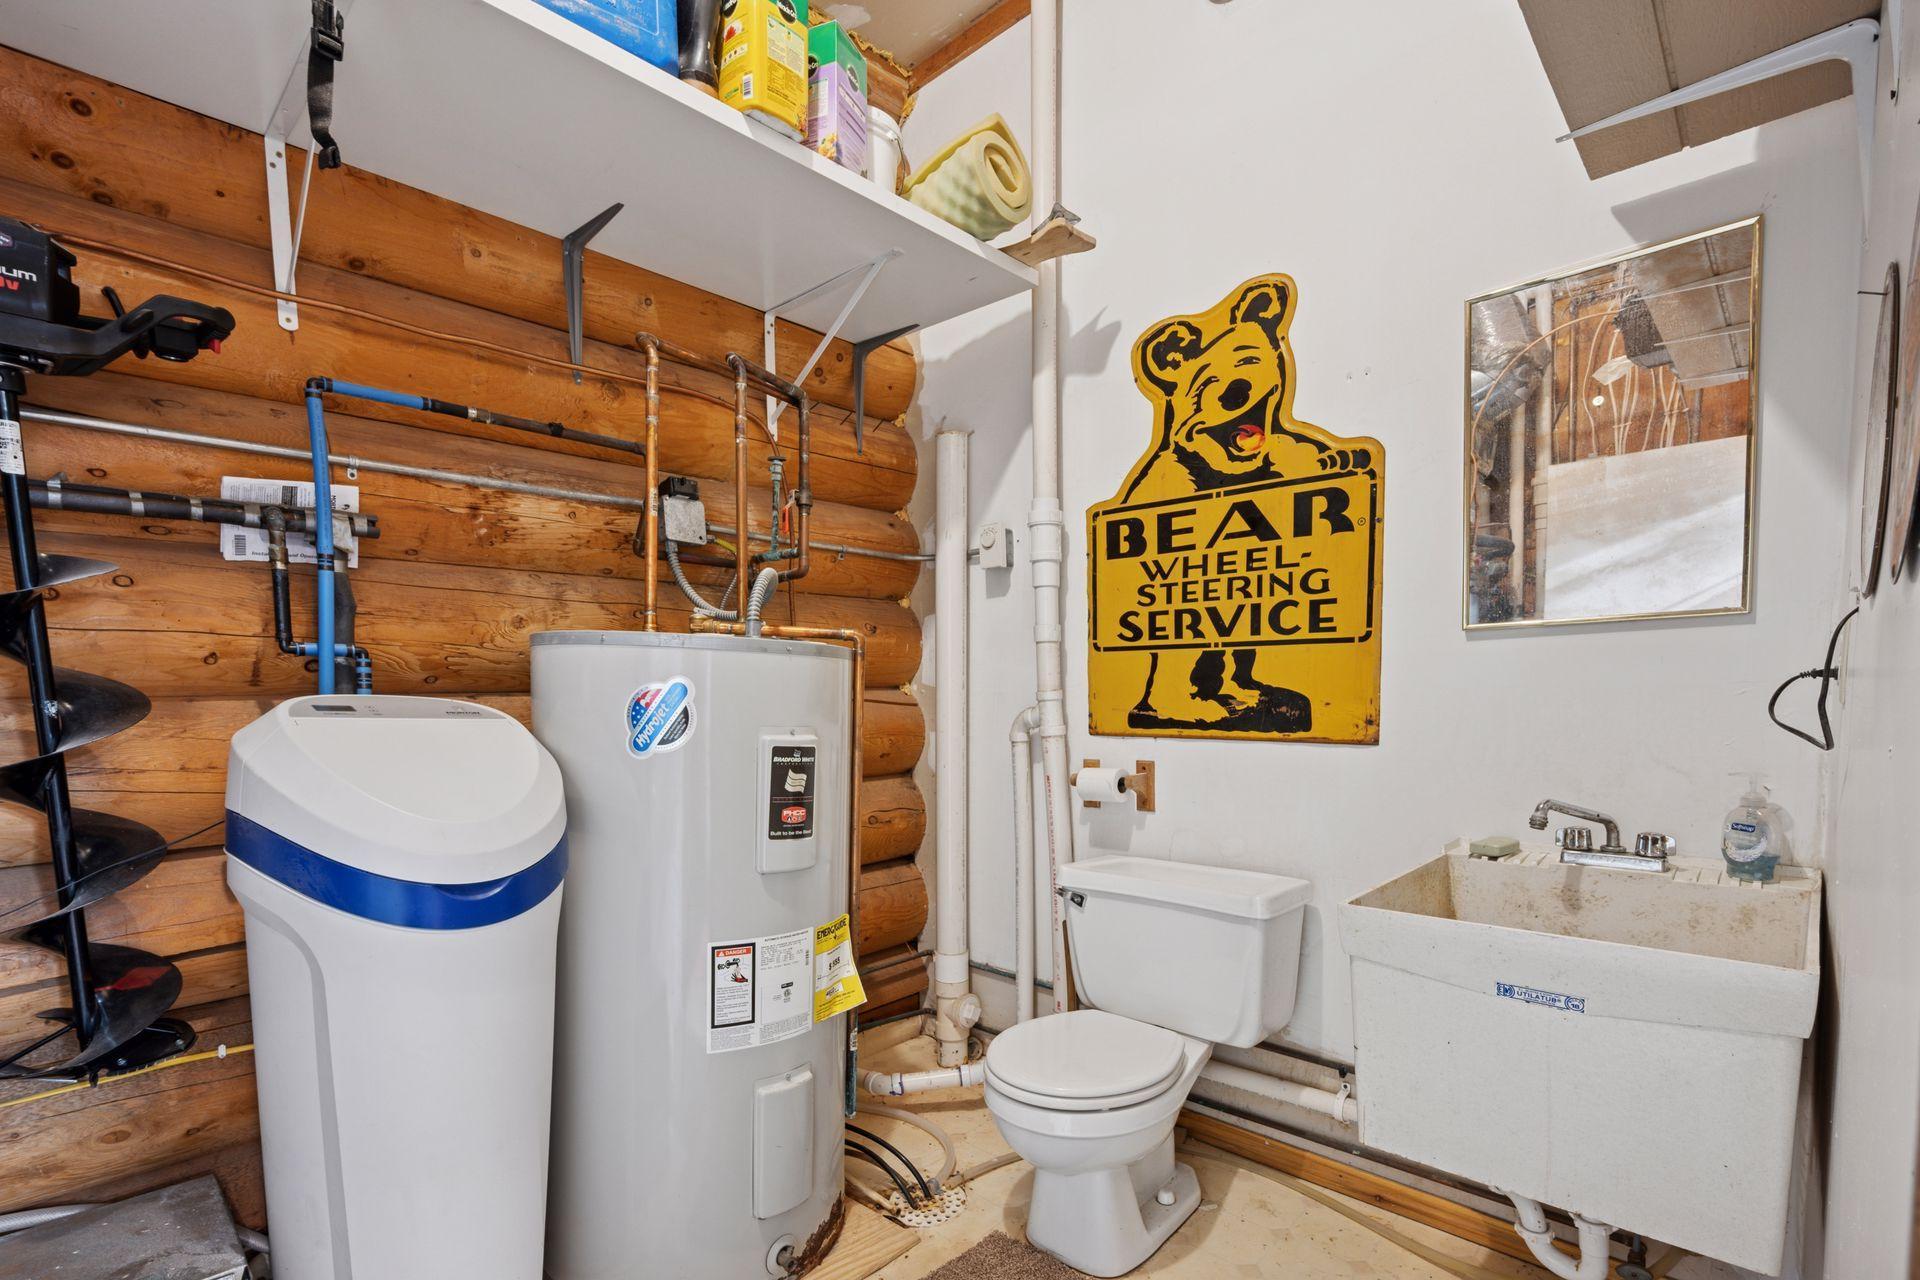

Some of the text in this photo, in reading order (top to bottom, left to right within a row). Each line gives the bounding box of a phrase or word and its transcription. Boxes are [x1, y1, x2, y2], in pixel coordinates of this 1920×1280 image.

[1105, 486, 1355, 560] BEAR
[1140, 544, 1312, 582] WHEEL-
[1137, 568, 1330, 607] STEERING
[1116, 598, 1338, 643] SERVICE
[635, 703, 669, 748] Hydrojet
[725, 948, 747, 957] DANGER
